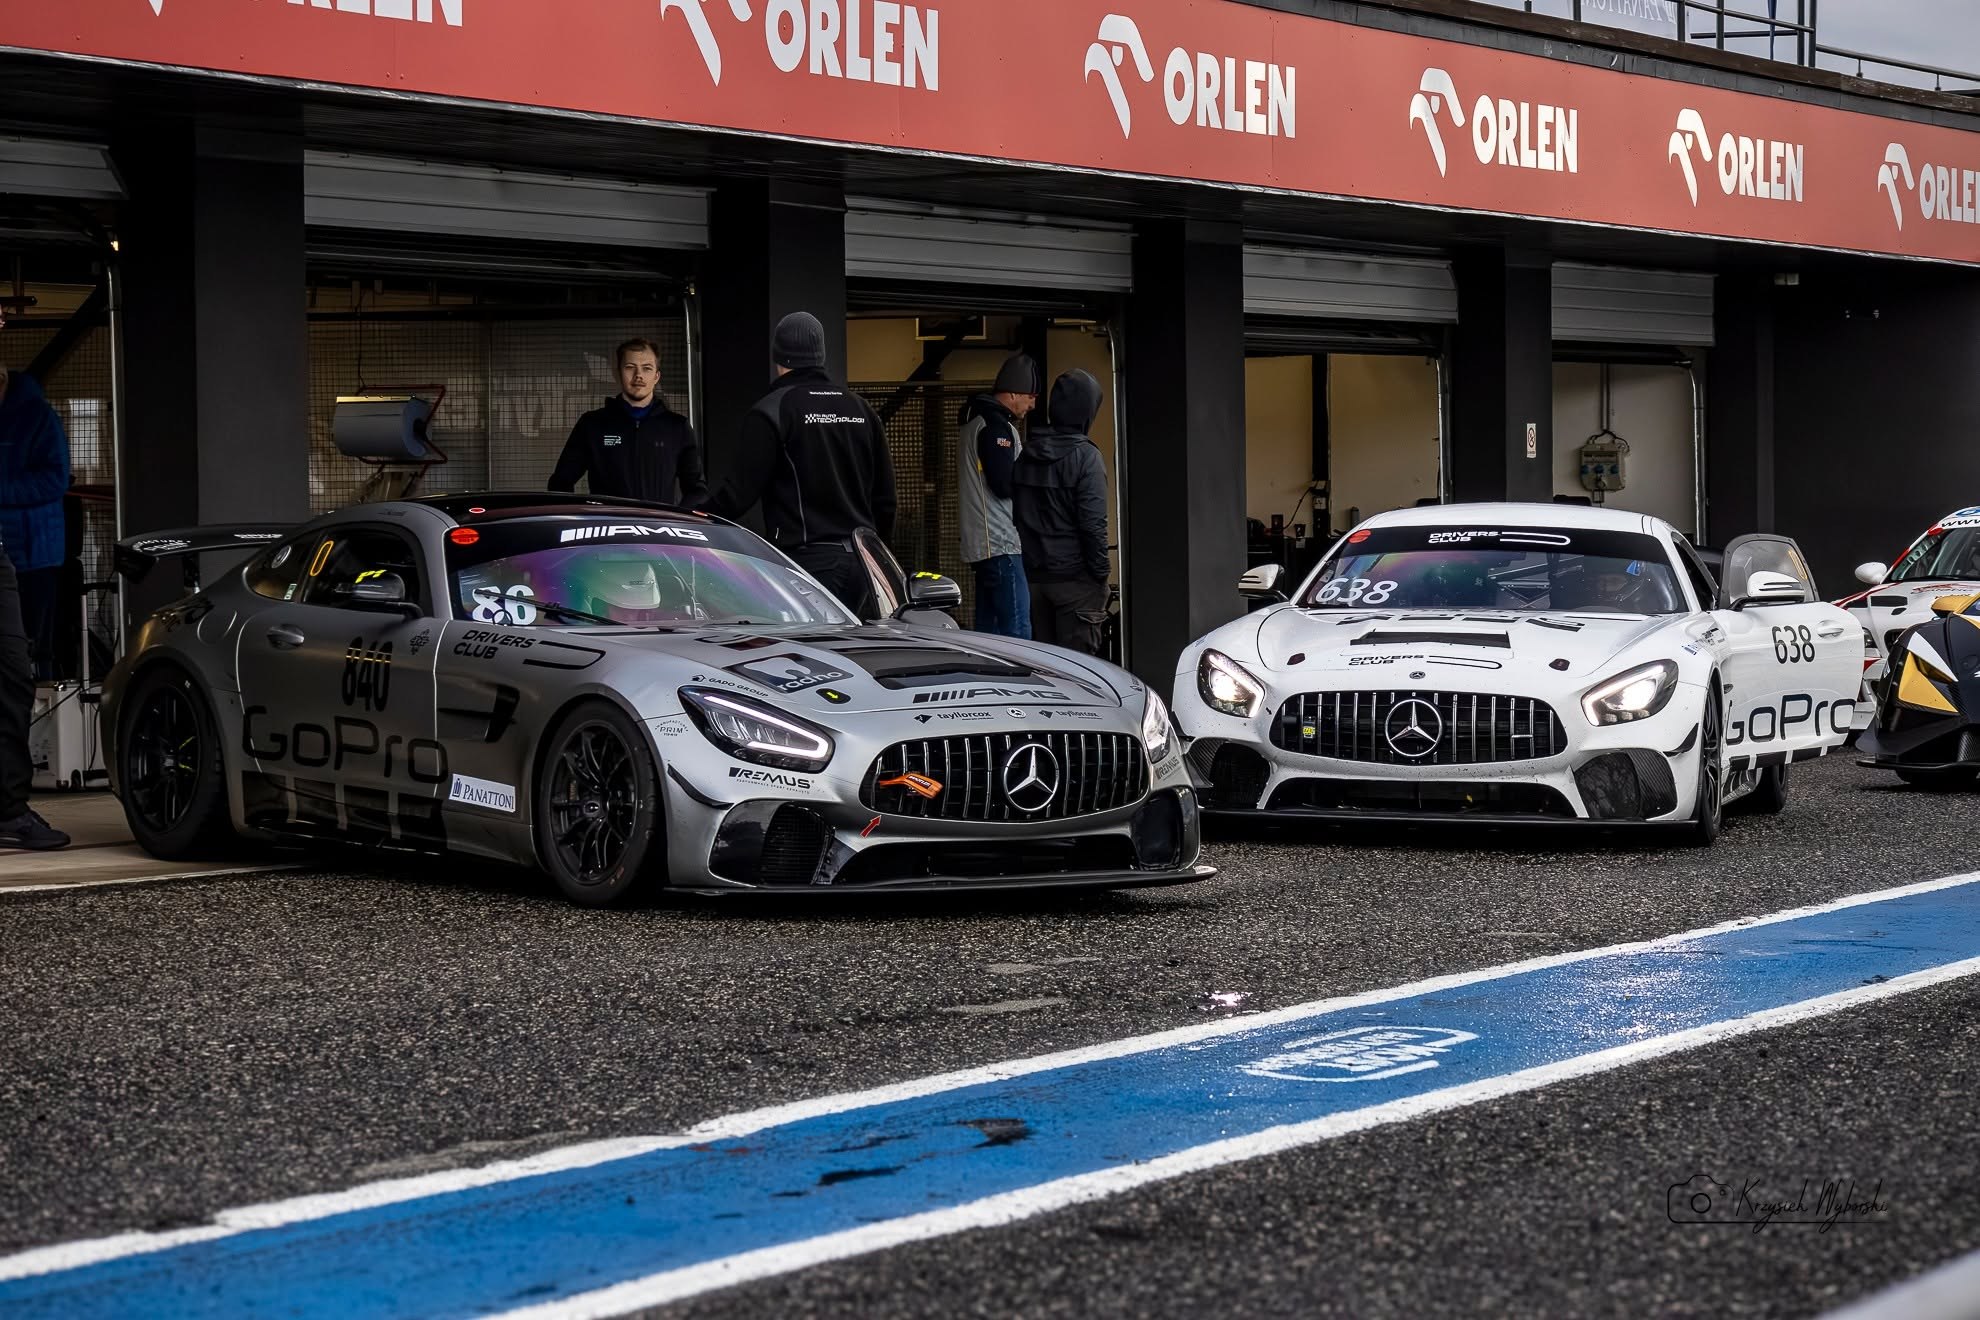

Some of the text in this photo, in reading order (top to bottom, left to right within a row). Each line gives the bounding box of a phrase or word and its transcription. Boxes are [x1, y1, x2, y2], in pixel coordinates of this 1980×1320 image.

[765, 0, 939, 91] ORLEN
[1163, 46, 1296, 138] ORLEN
[1472, 94, 1578, 174] ORLEN
[1718, 133, 1804, 203] ORLEN
[608, 525, 709, 542] AMG
[1427, 536, 1472, 544] CLUB
[1429, 530, 1499, 539] DRIVERS
[1315, 577, 1399, 604] 638
[471, 584, 537, 626] 86
[462, 629, 537, 649] DRIVERS
[1771, 624, 1816, 664] 638
[453, 642, 499, 660] CLUB
[1349, 654, 1424, 662] DRIVERS
[1348, 659, 1395, 667] CLUB
[341, 636, 393, 712] 840
[708, 677, 769, 698] GADO GROUP
[966, 688, 1072, 701] AMG
[937, 711, 992, 721] tayllorcox
[1725, 693, 1857, 746] GoPro
[659, 726, 684, 734] PRIM
[242, 705, 449, 784] GoPro
[737, 768, 811, 789] REMUS
[462, 783, 515, 810] PANATTONI
